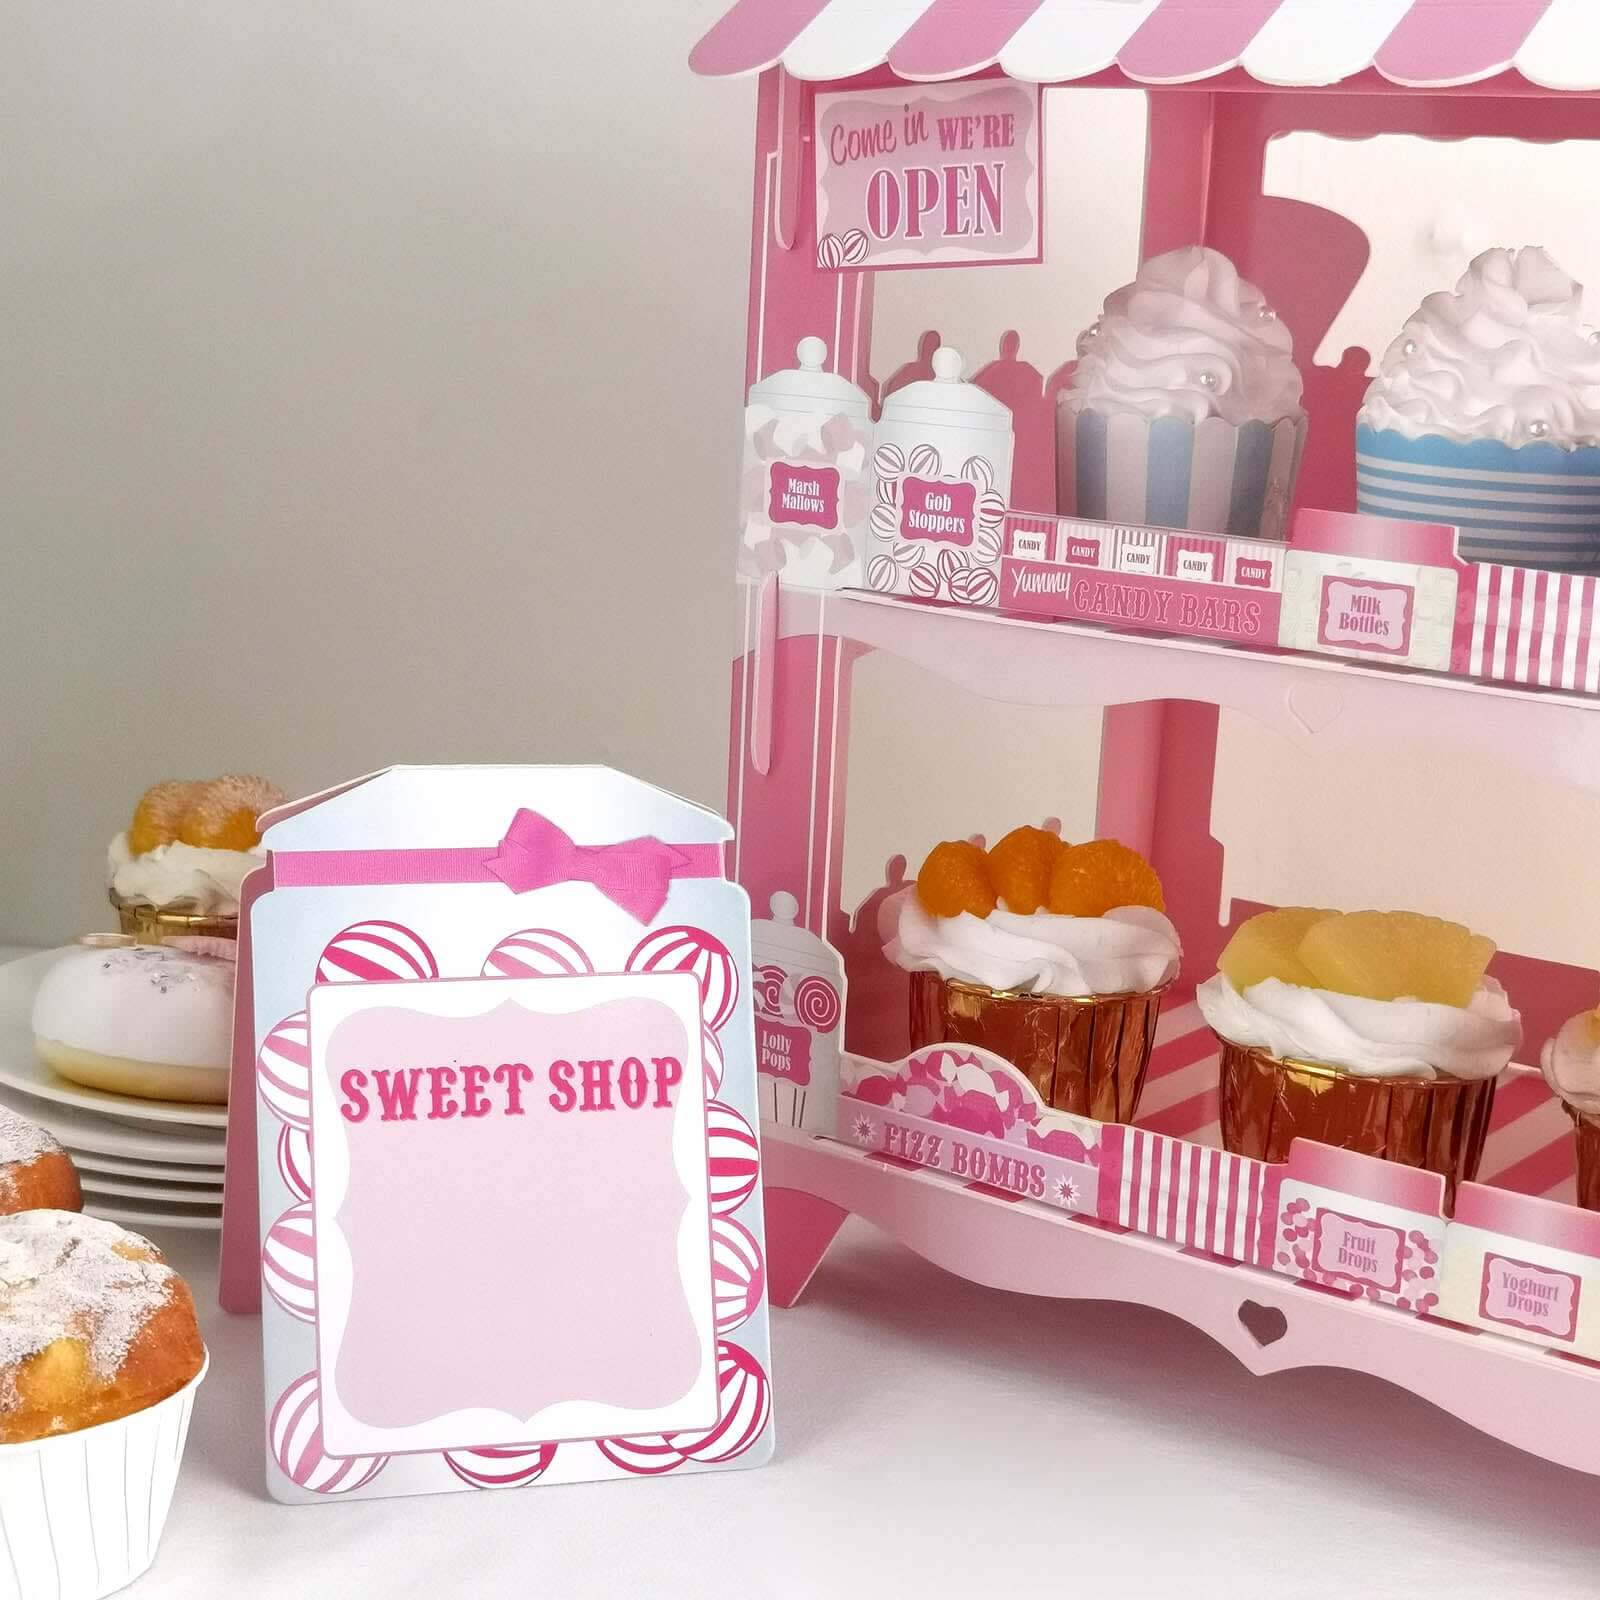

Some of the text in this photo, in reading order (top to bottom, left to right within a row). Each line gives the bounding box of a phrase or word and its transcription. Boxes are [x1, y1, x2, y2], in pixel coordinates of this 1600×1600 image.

[830, 104, 1015, 166] Come in WE'RE
[866, 162, 1004, 241] OPEN
[788, 478, 819, 497] Marsh
[782, 493, 825, 513] Mallows
[925, 492, 951, 512] Gob
[908, 509, 966, 534] Stoppers
[1018, 538, 1042, 551] CANDY
[1071, 545, 1096, 558] CANDY
[1126, 552, 1151, 565] CANDY
[1183, 559, 1208, 573] CANDY
[1240, 566, 1267, 580] CANDY
[1012, 566, 1262, 635] Yummy CANDY BARS
[1350, 594, 1382, 615] Milk
[1339, 612, 1390, 636] Bottles
[762, 1030, 792, 1053] Lolly
[761, 1048, 791, 1072] Pops
[340, 1056, 682, 1123] SWEET SHOP
[884, 1122, 1046, 1197] FIZZ BOMBS
[1343, 1231, 1376, 1255] Fruit
[1337, 1249, 1378, 1273] Drops
[1501, 1272, 1560, 1301] Yoghurt
[1507, 1292, 1549, 1316] Drops
